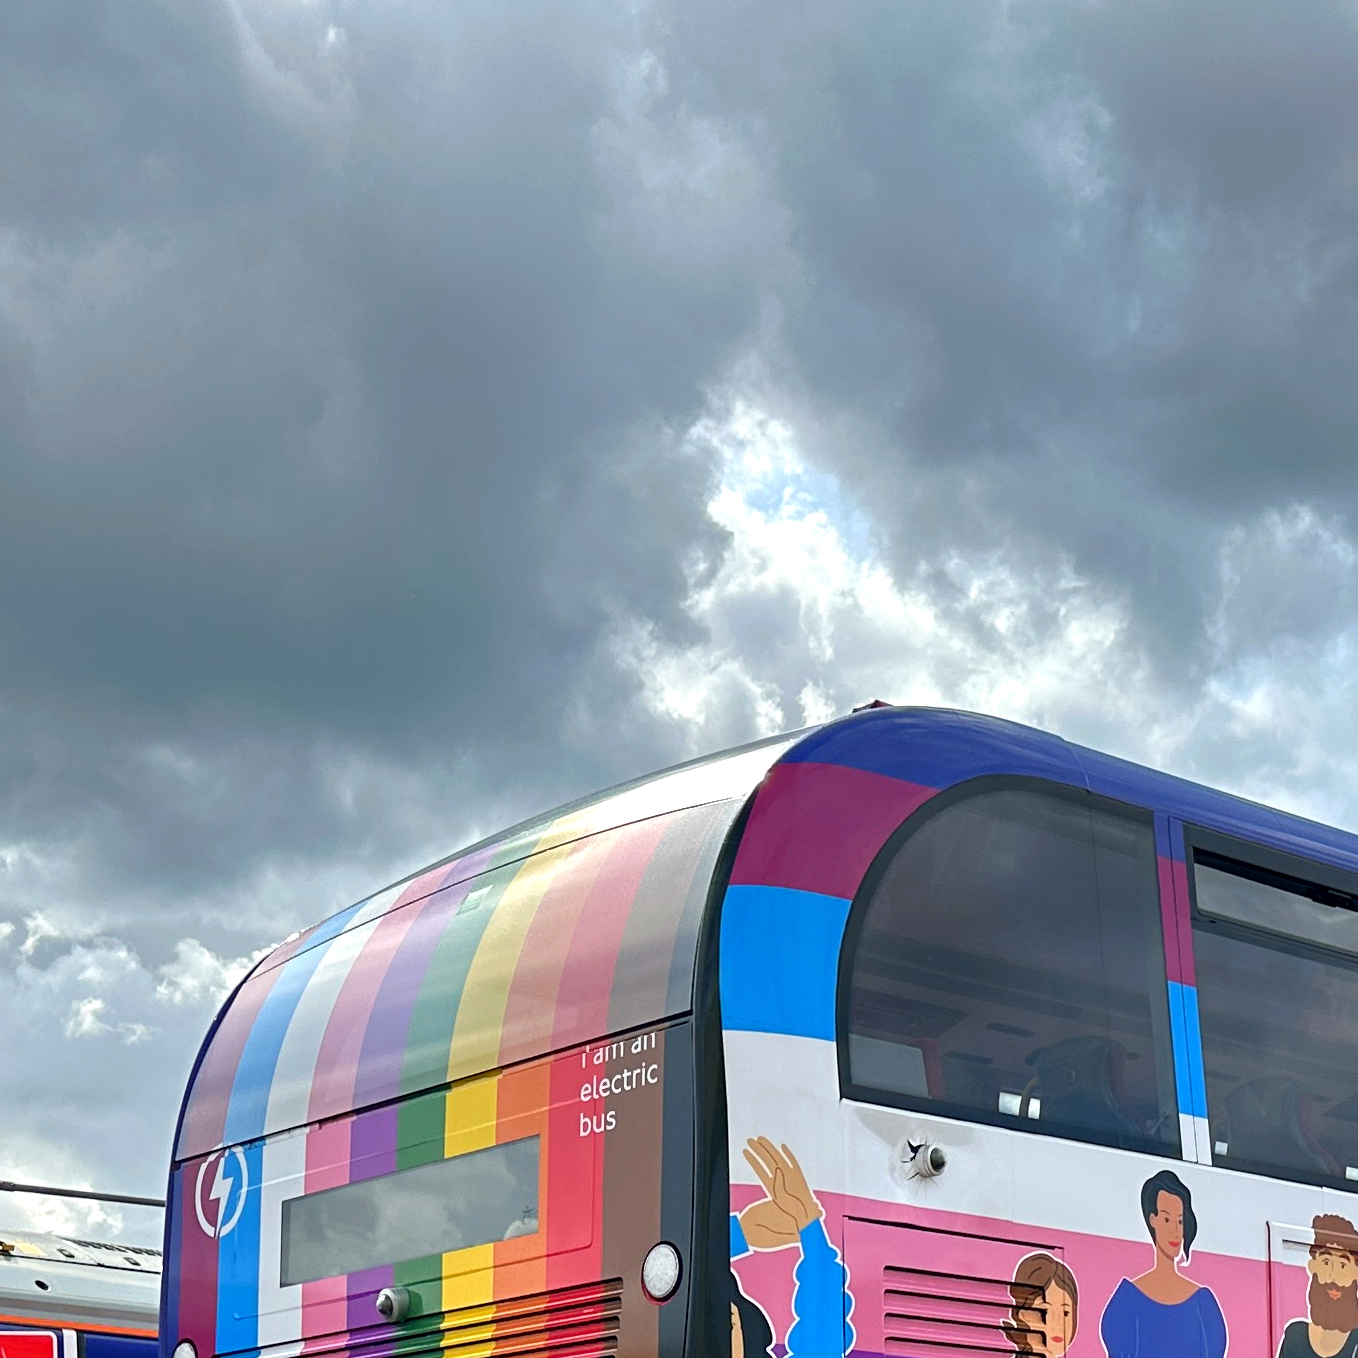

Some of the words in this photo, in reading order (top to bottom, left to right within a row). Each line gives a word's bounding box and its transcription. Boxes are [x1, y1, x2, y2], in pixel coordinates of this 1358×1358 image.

[593, 1041, 624, 1065] am
[631, 1032, 656, 1054] an
[580, 1061, 658, 1102] electric
[579, 1110, 616, 1137] bus
